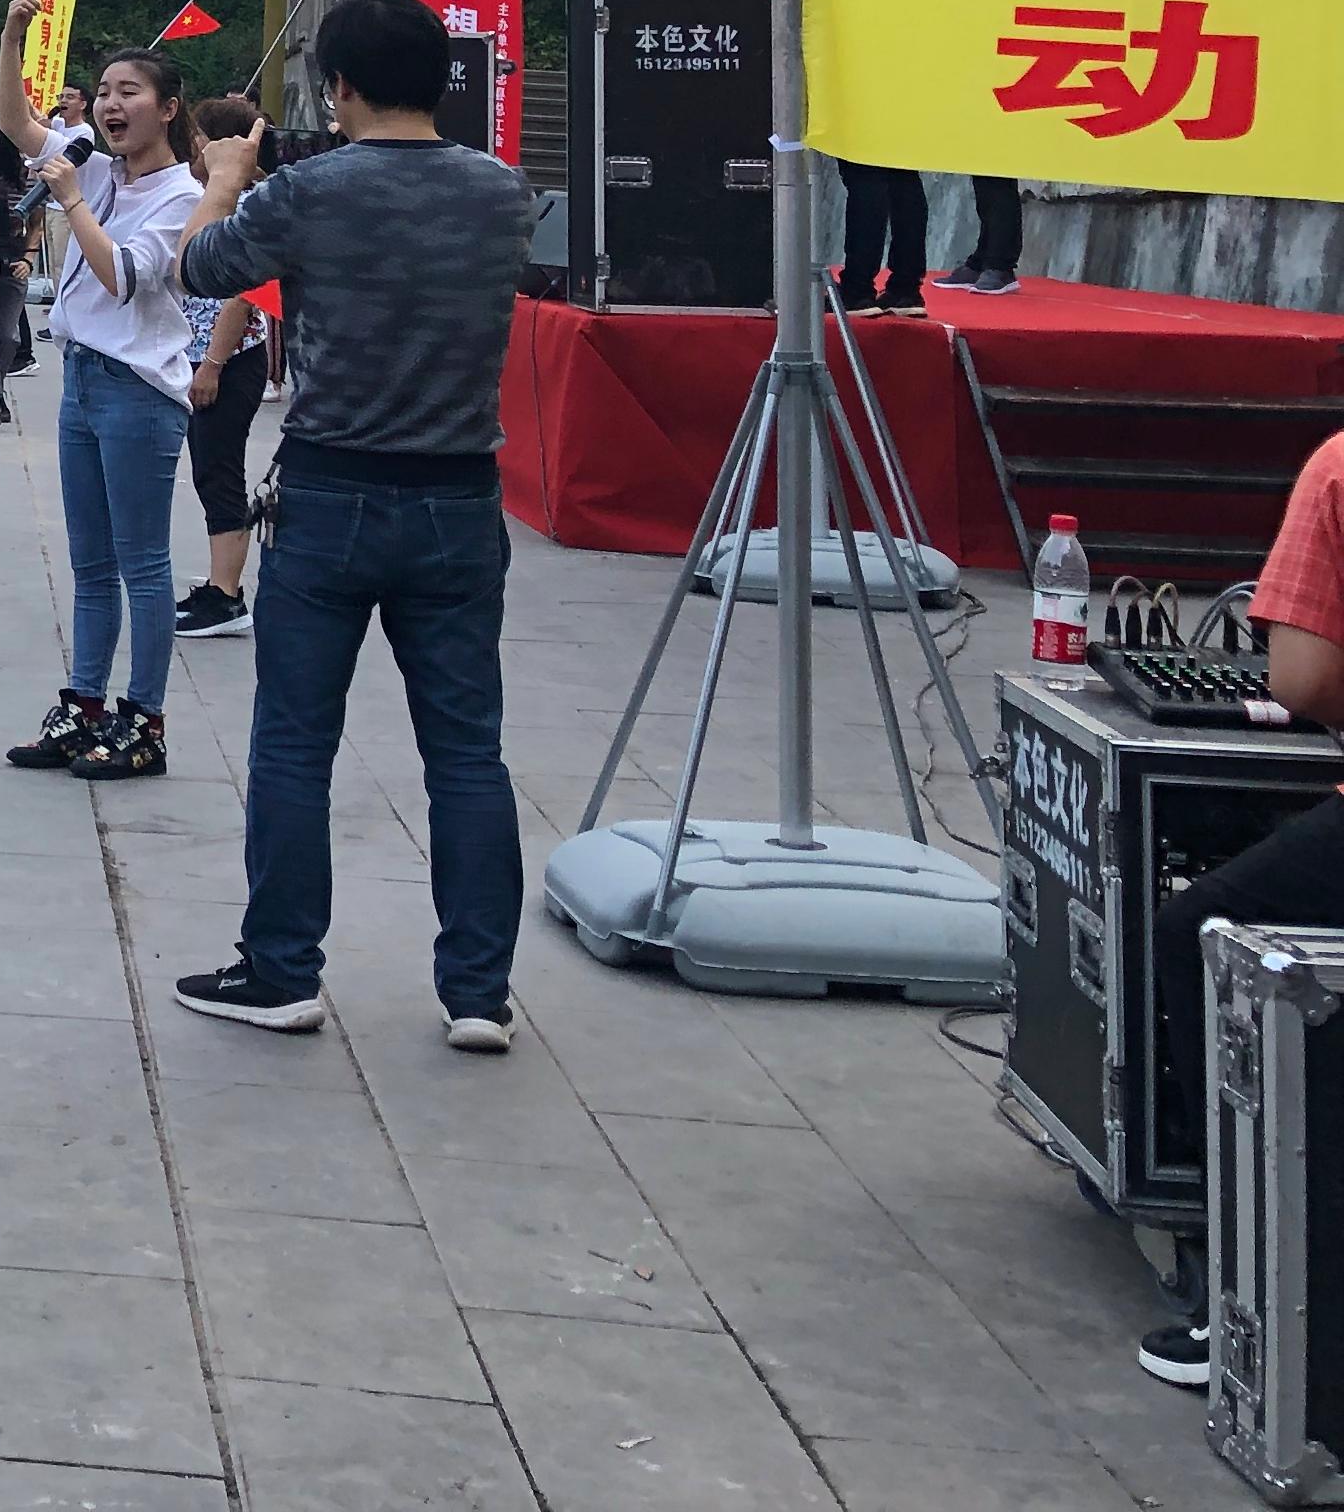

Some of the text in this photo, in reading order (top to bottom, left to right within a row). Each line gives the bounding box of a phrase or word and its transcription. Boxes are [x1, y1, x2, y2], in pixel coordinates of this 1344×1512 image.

[634, 24, 740, 54] 本色文化
[1013, 719, 1090, 847] 本色文化
